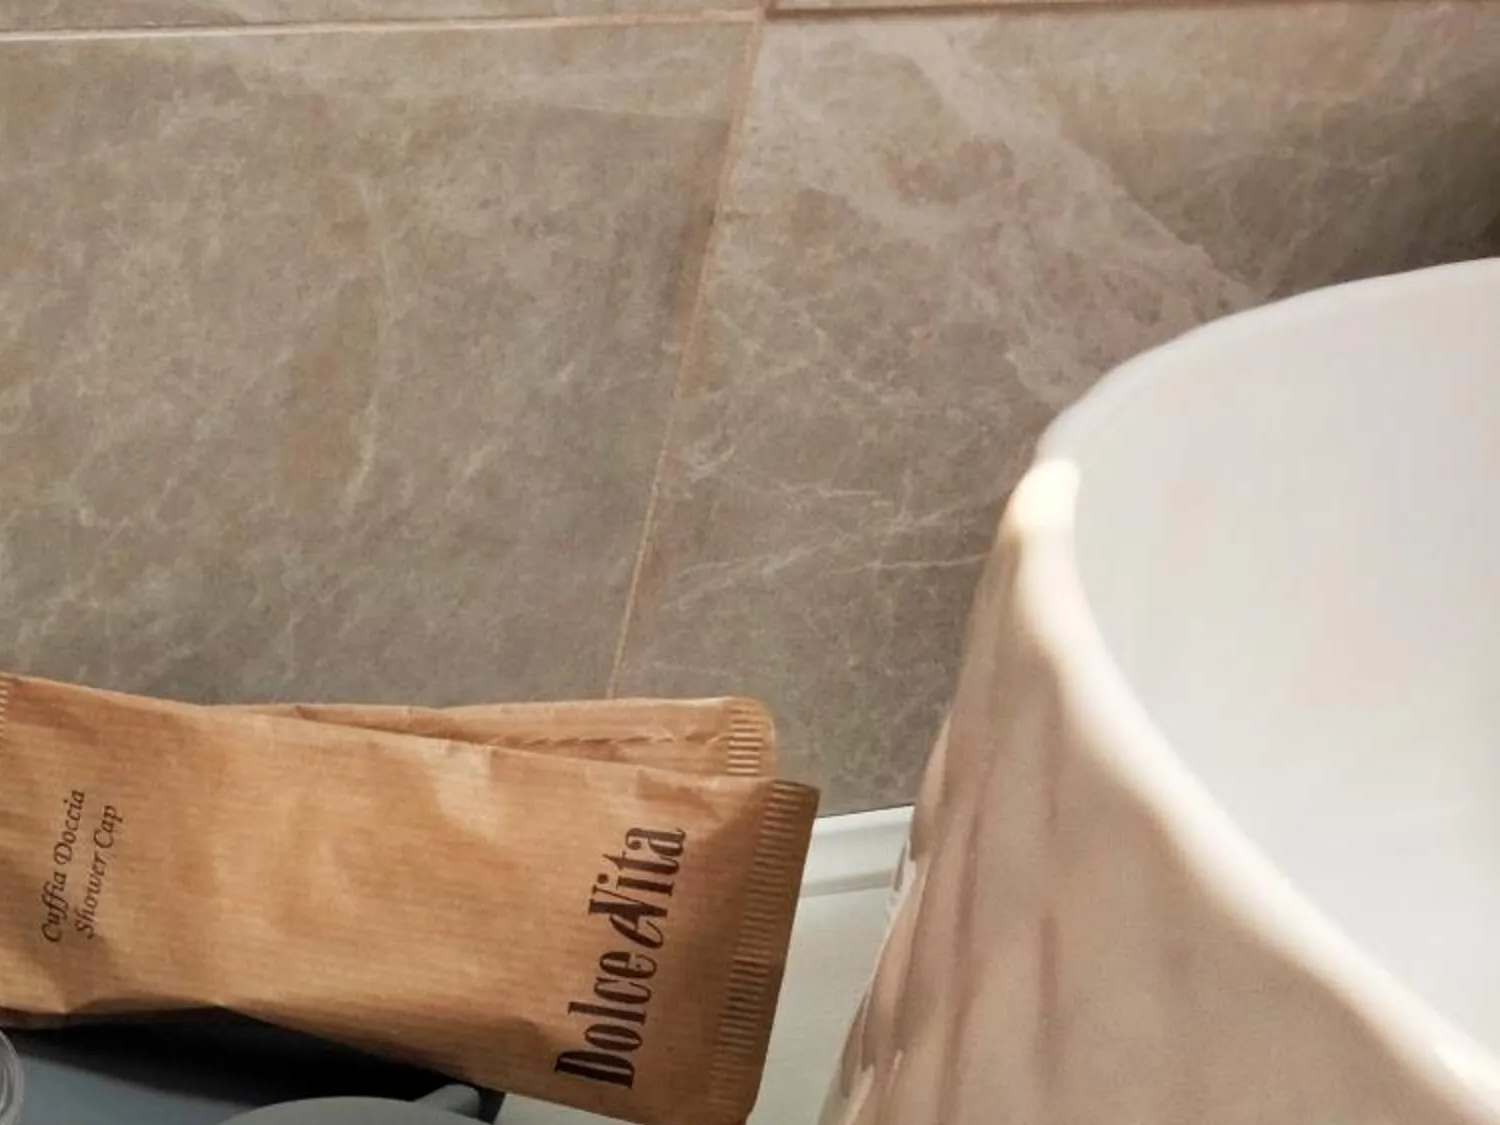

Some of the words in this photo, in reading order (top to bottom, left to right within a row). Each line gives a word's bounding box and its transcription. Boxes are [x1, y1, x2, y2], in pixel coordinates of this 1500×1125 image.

[52, 789, 85, 866] Doccia
[41, 871, 69, 943] Cuffia
[74, 851, 108, 940] Shower
[93, 804, 124, 849] Cap
